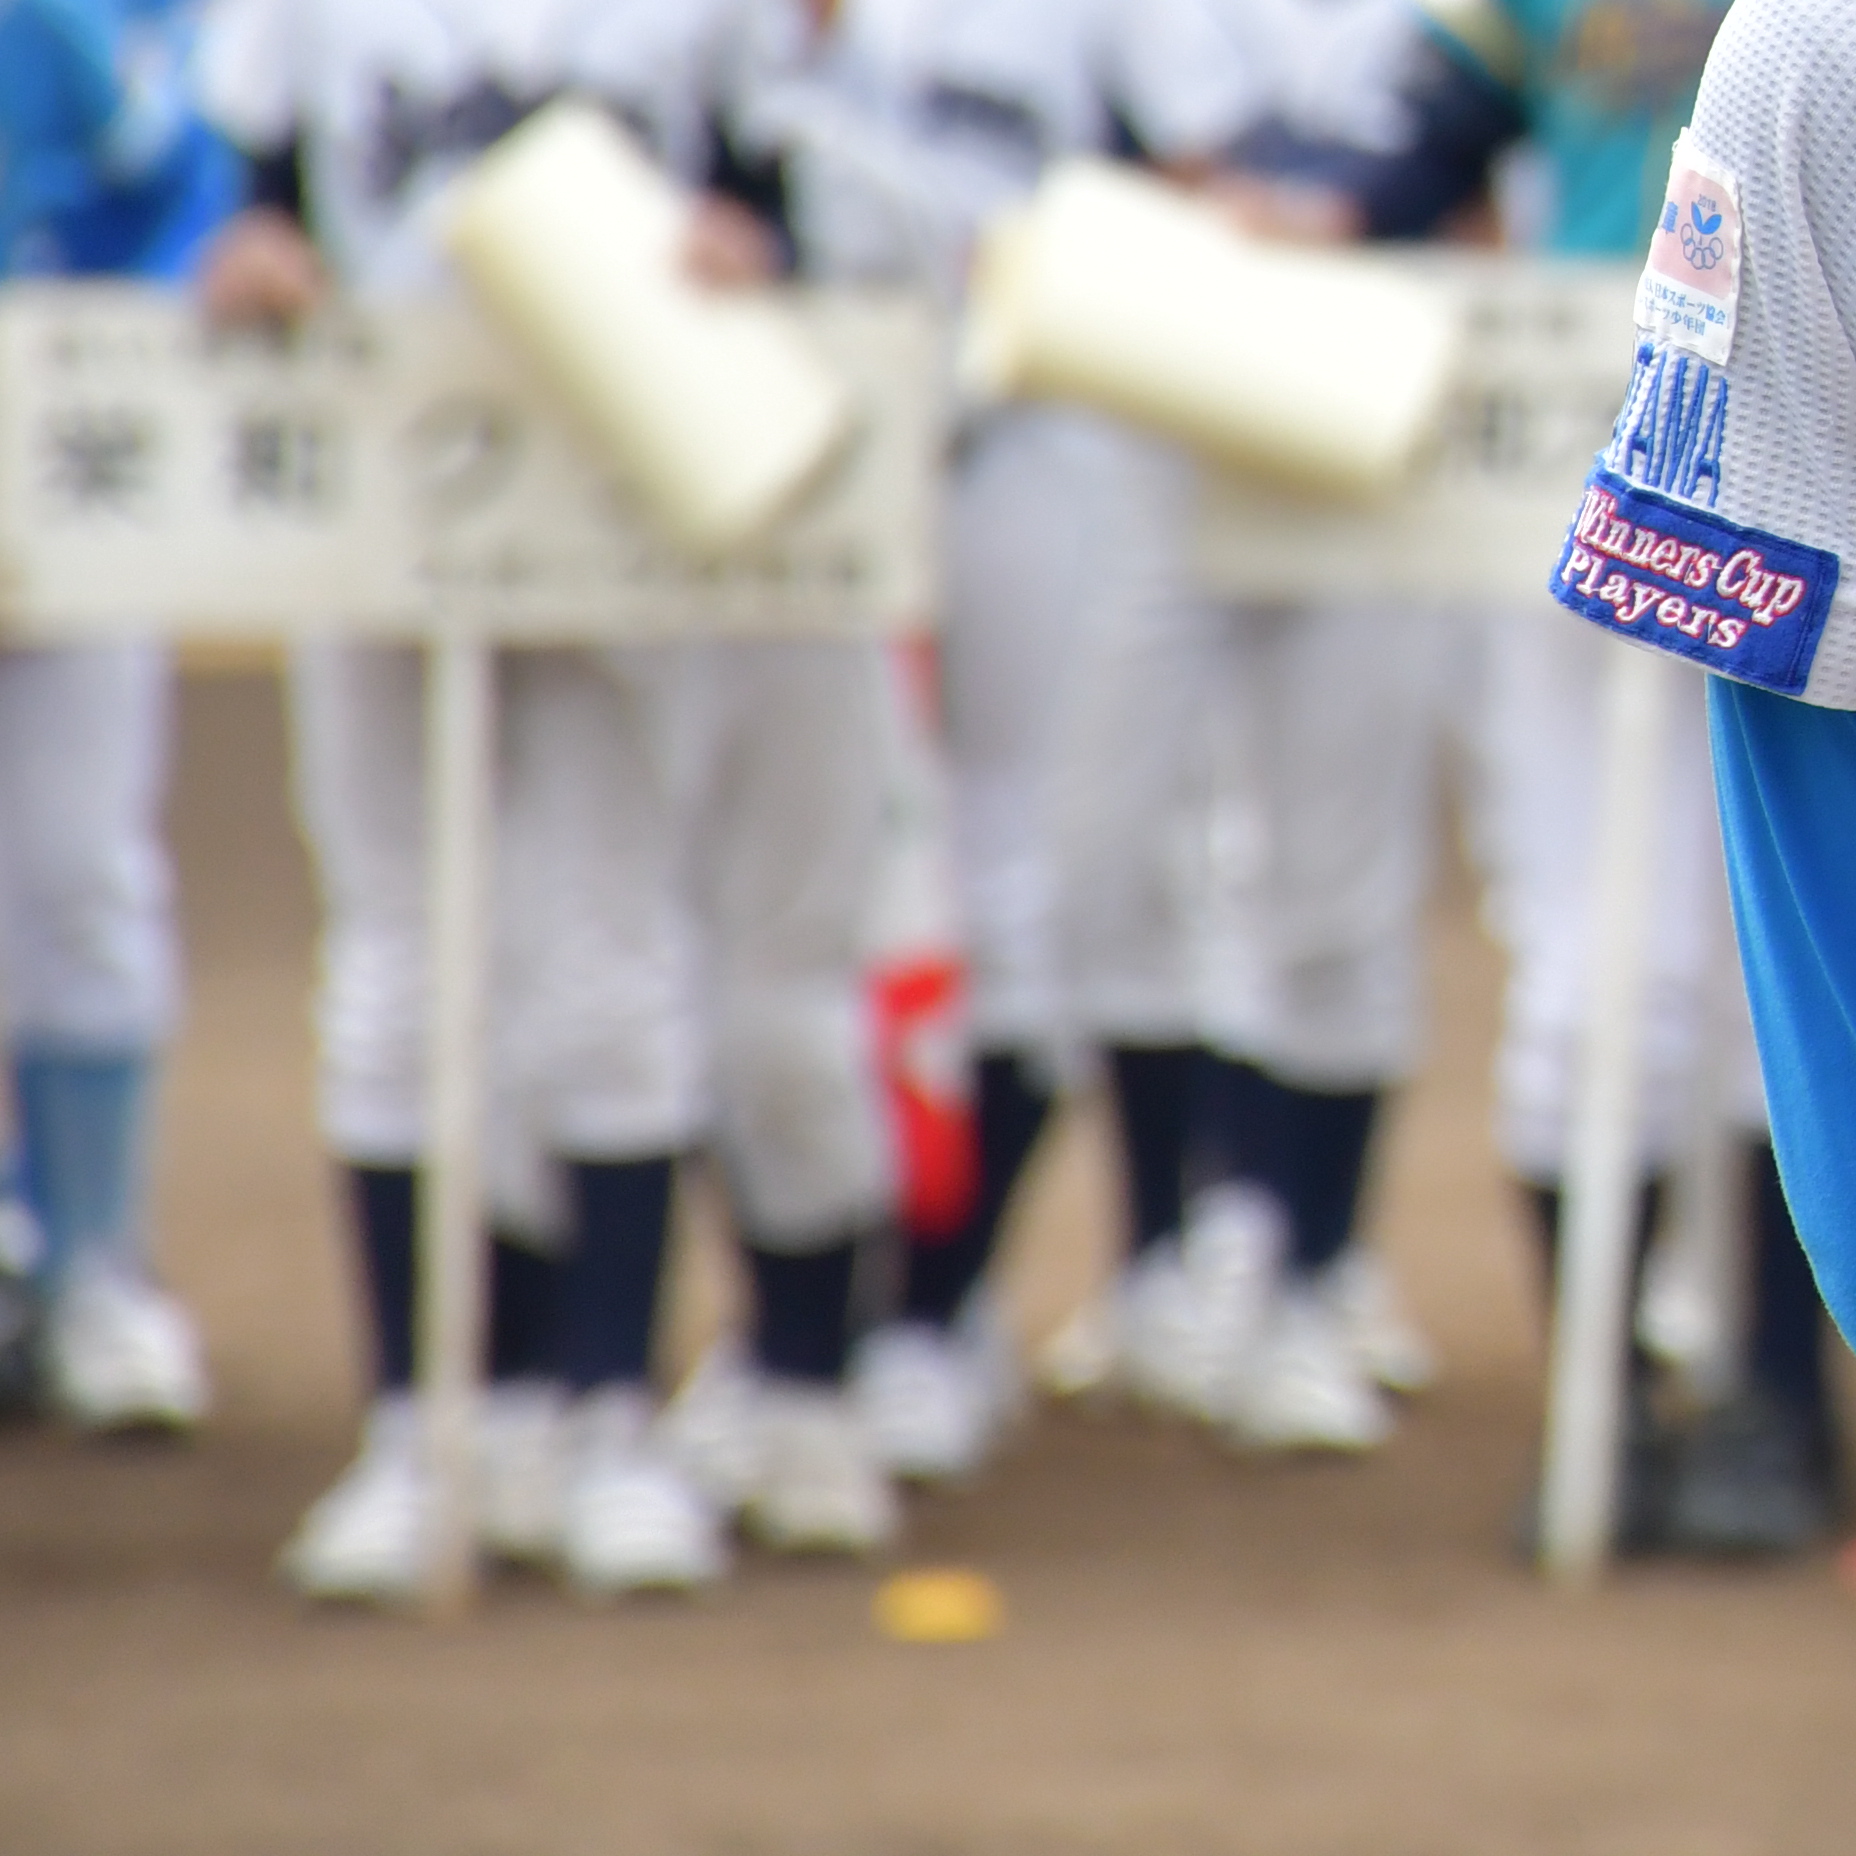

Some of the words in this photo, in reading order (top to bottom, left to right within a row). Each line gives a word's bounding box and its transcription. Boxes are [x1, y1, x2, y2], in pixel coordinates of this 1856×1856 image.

[1697, 193, 1716, 212] 2018
[1560, 543, 1749, 650] Players
[1573, 486, 1722, 587] Winners
[1716, 548, 1806, 626] Cup
